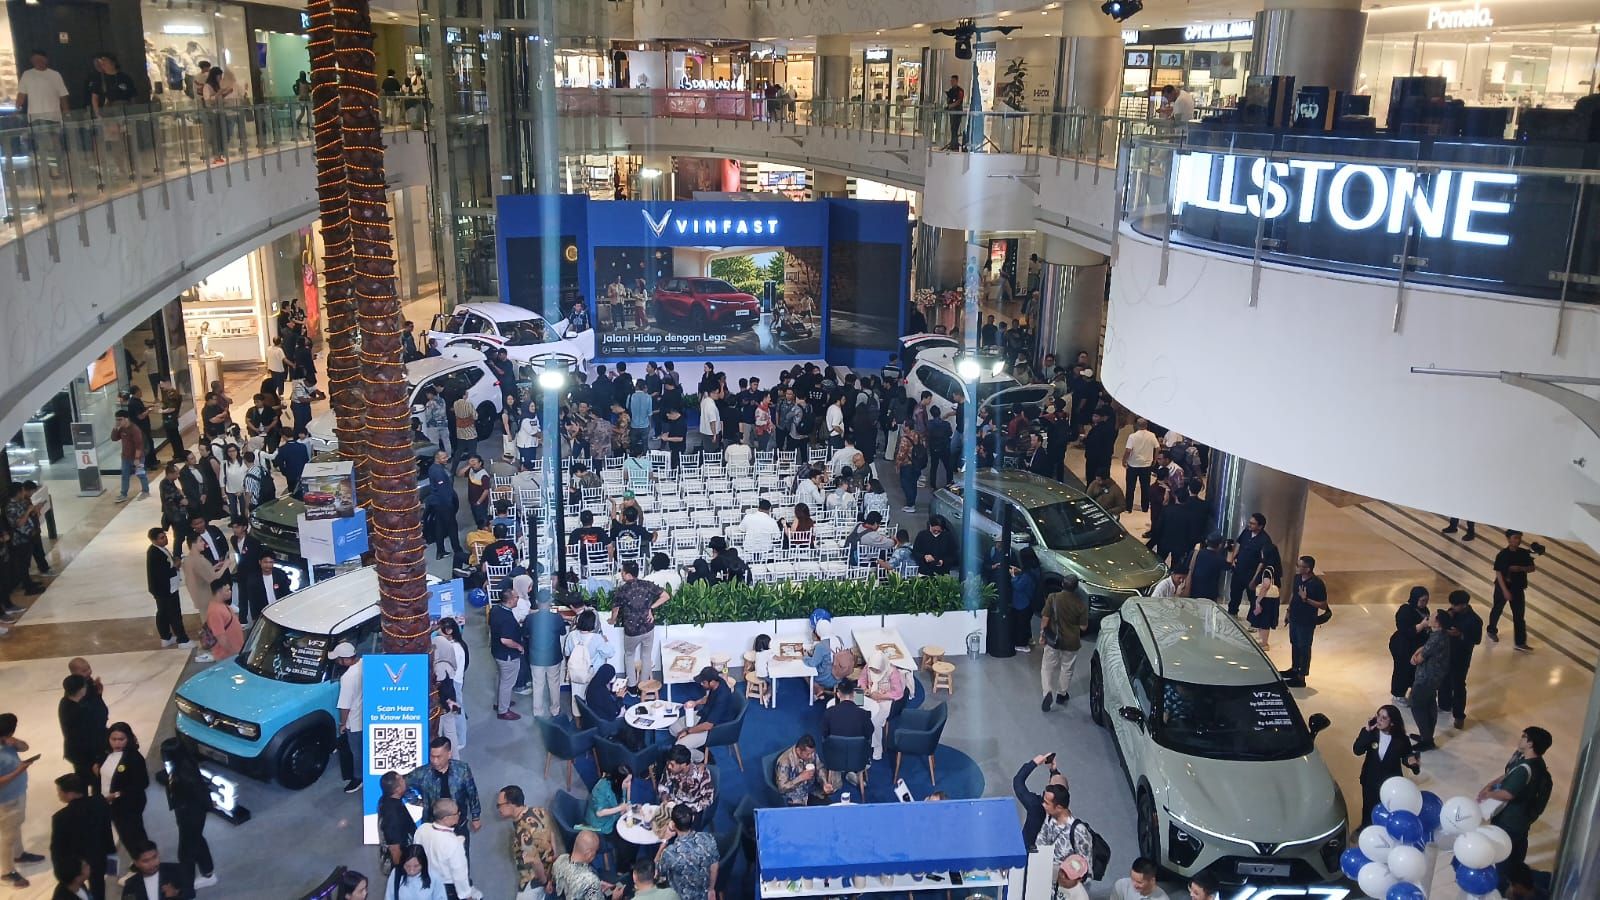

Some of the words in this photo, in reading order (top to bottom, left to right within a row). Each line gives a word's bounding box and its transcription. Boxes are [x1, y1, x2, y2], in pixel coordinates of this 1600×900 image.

[1428, 7, 1494, 29] Pomelo.
[677, 219, 779, 234] VINFAST
[602, 333, 631, 344] Jalani
[633, 333, 662, 344] Hidup
[665, 333, 701, 344] dengan
[703, 333, 727, 344] Lega
[379, 713, 401, 721] Know
[402, 713, 421, 721] More
